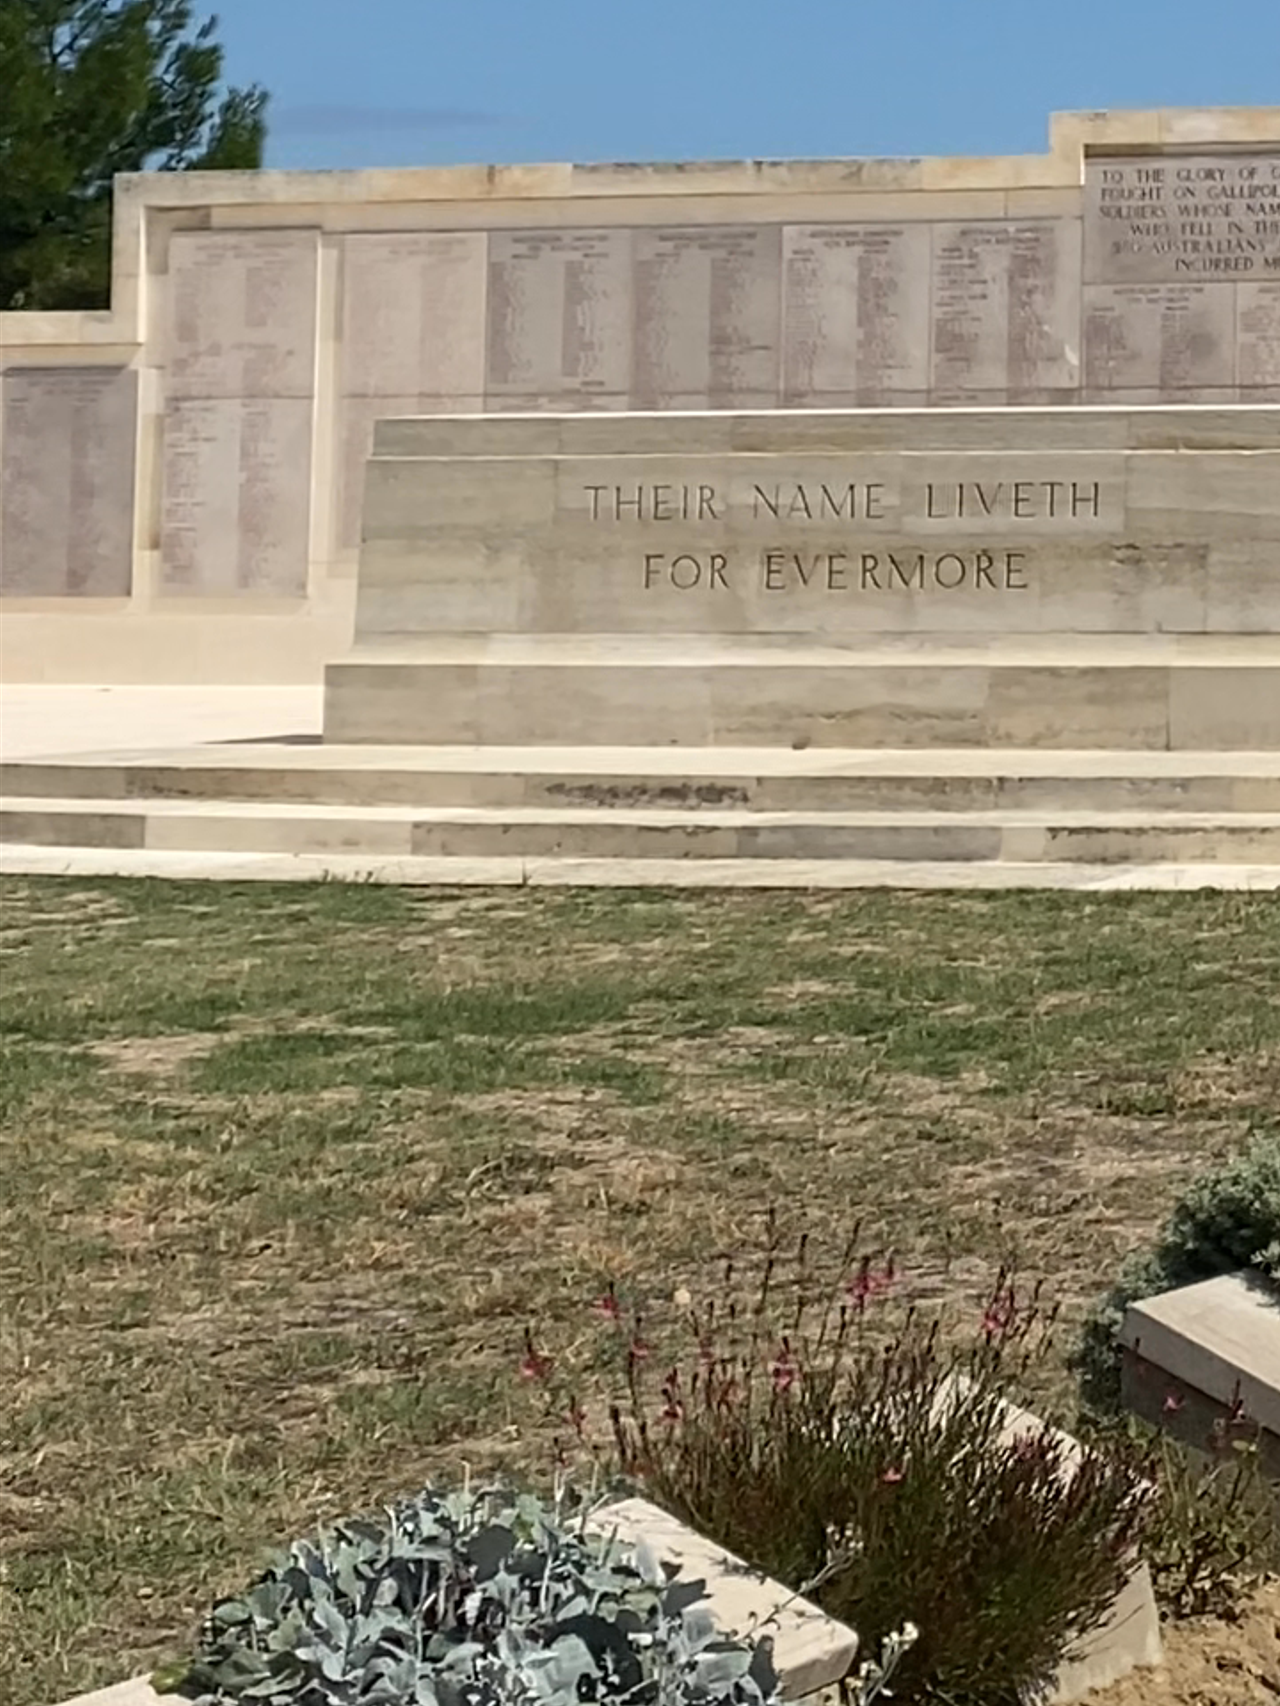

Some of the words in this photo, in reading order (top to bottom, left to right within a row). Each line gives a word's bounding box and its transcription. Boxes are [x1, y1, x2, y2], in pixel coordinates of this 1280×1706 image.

[1103, 170, 1123, 184] TO
[1137, 168, 1164, 183] THE
[1177, 168, 1225, 182] GLORY
[1239, 167, 1257, 180] OF
[1101, 187, 1163, 201] FOUGHT
[1174, 186, 1196, 199] ON
[1100, 205, 1166, 219] SOLDIERS
[1178, 203, 1232, 217] WHOSE
[1130, 223, 1169, 236] WHO
[1228, 221, 1244, 234] IN
[1254, 220, 1279, 234] THE
[1153, 239, 1265, 254] AUSTRALIANS
[1175, 257, 1253, 272] INCURRED
[584, 484, 721, 521] THEIR
[752, 482, 886, 519] NAME
[925, 481, 1101, 518] LIVETH
[643, 553, 729, 590] FOR
[765, 549, 1030, 590] EVERMORE
